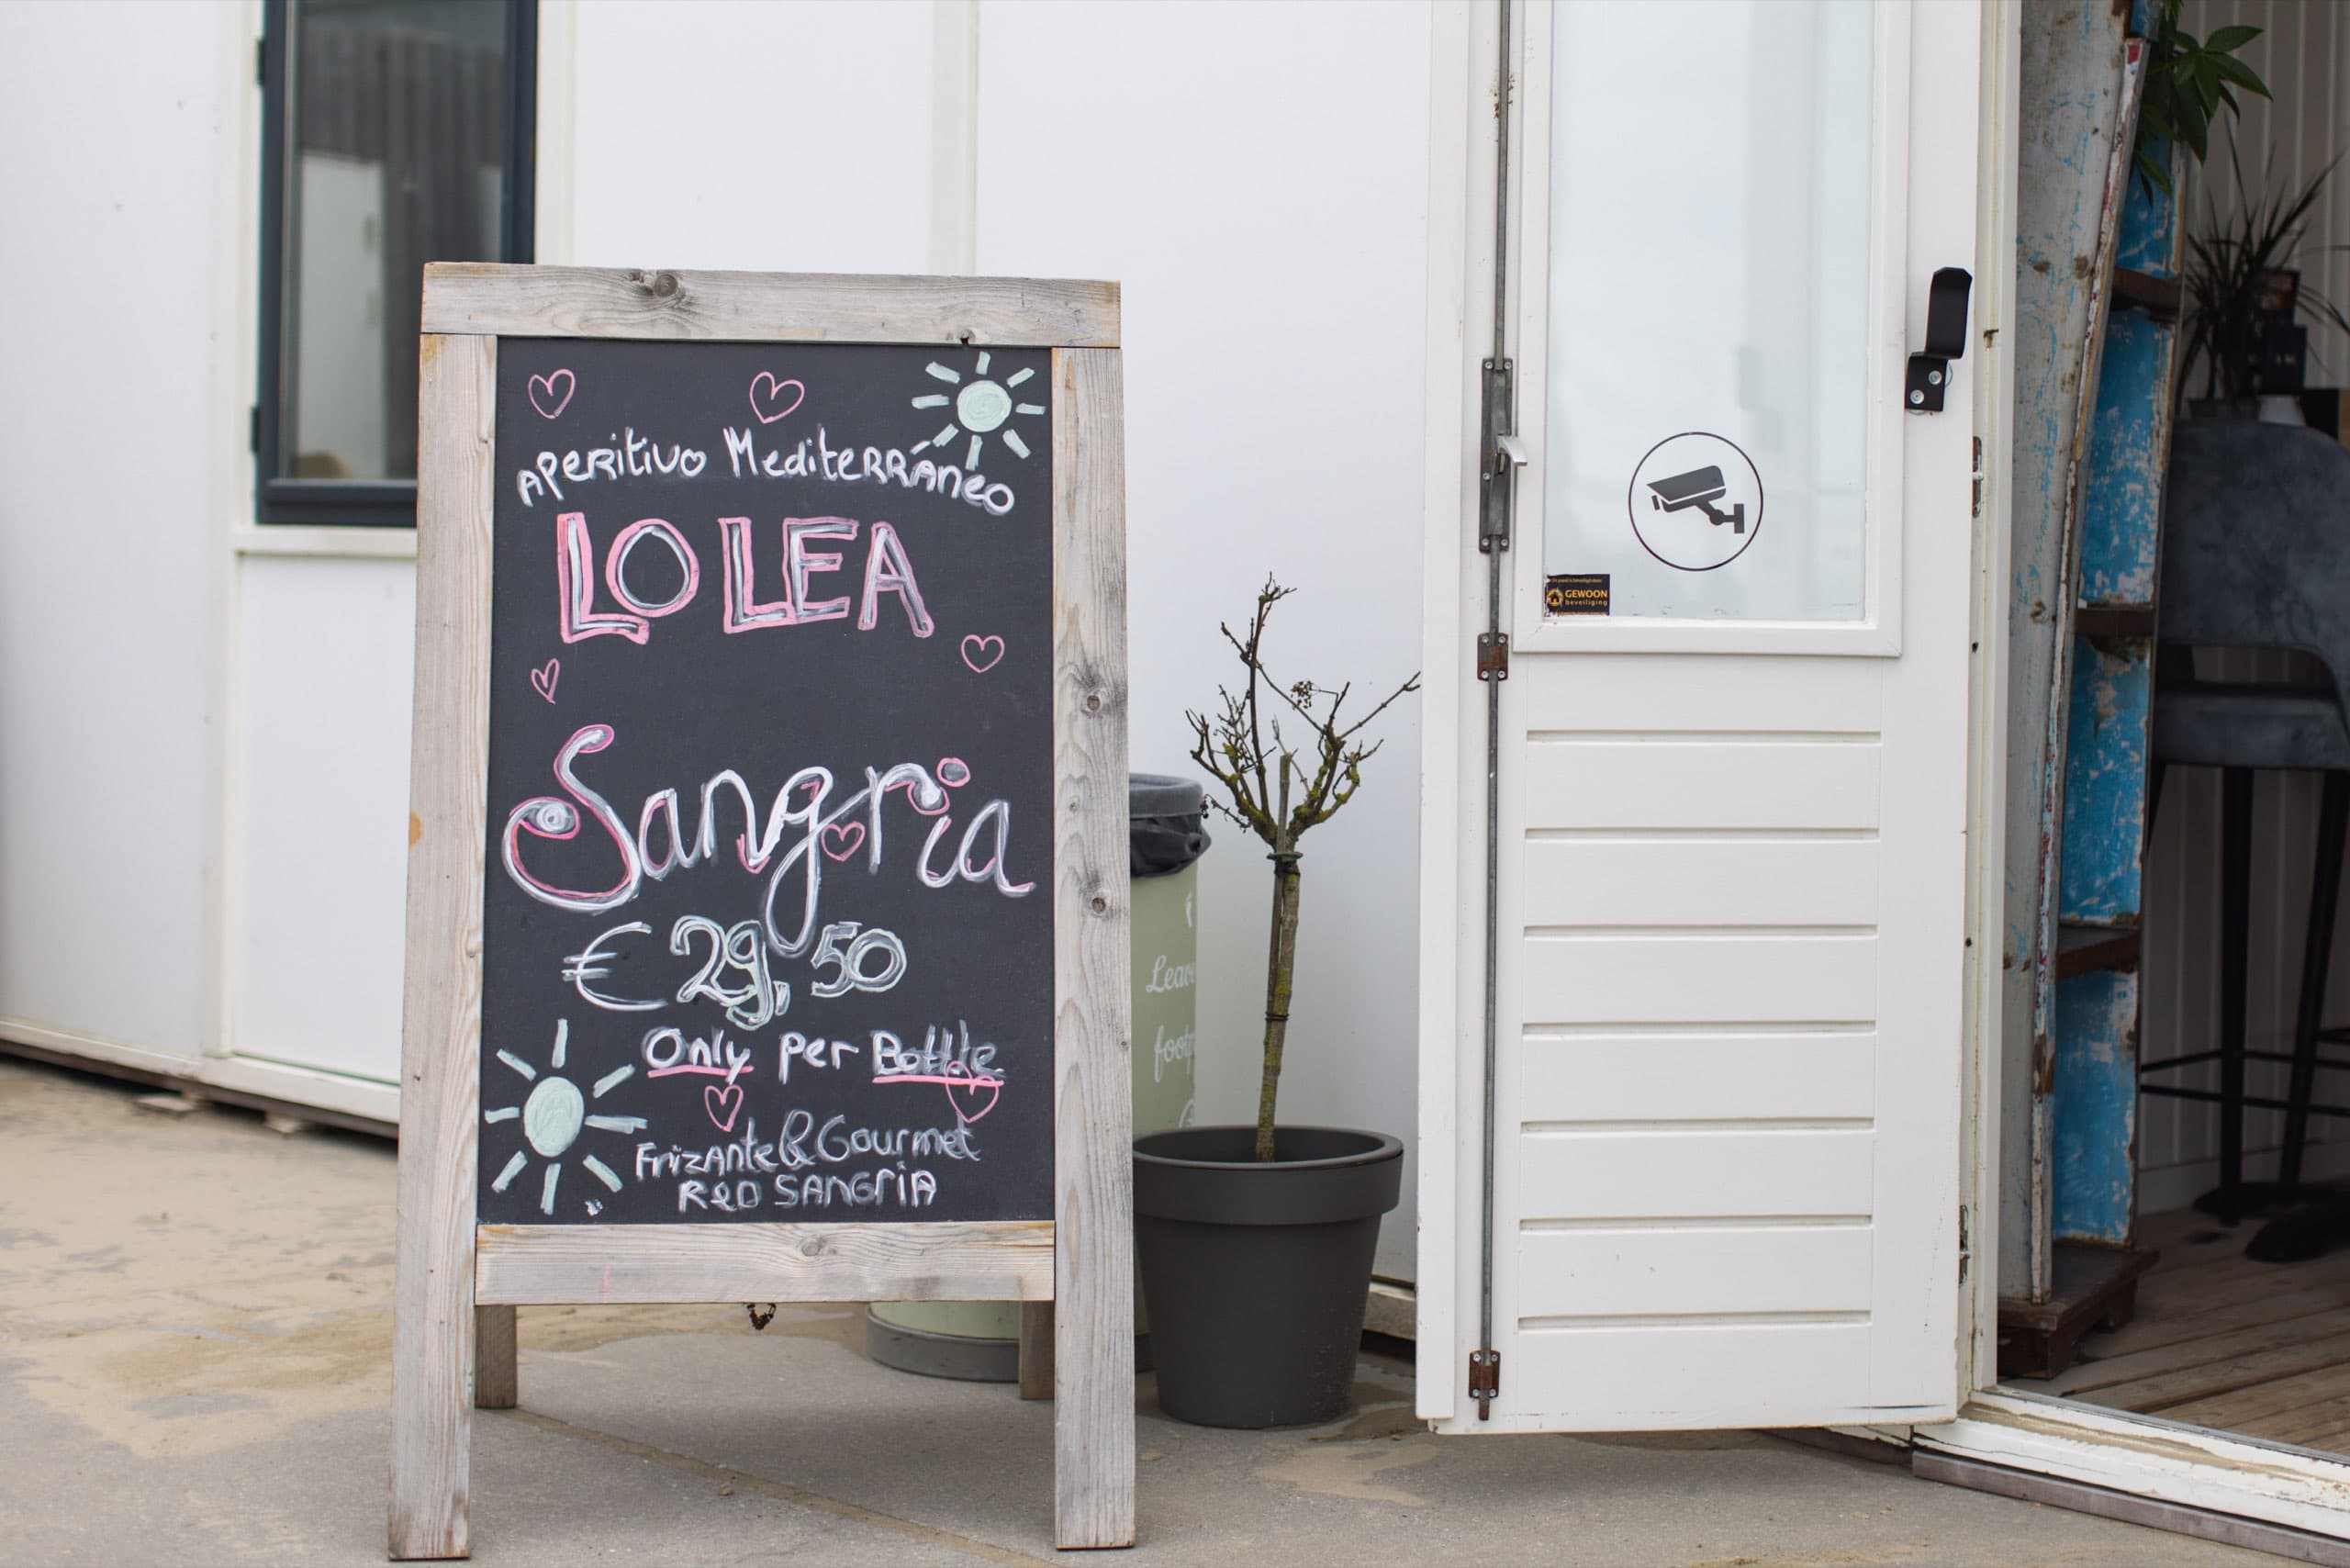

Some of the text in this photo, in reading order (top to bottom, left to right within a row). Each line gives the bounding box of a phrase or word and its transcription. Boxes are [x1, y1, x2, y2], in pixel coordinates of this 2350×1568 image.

[556, 512, 934, 644] LOLEA
[1564, 589, 1607, 598] GEWOON
[501, 724, 1037, 958] Sangria
[562, 921, 668, 1011] €
[642, 1025, 753, 1085] Only
[868, 1019, 1009, 1078] Bottle
